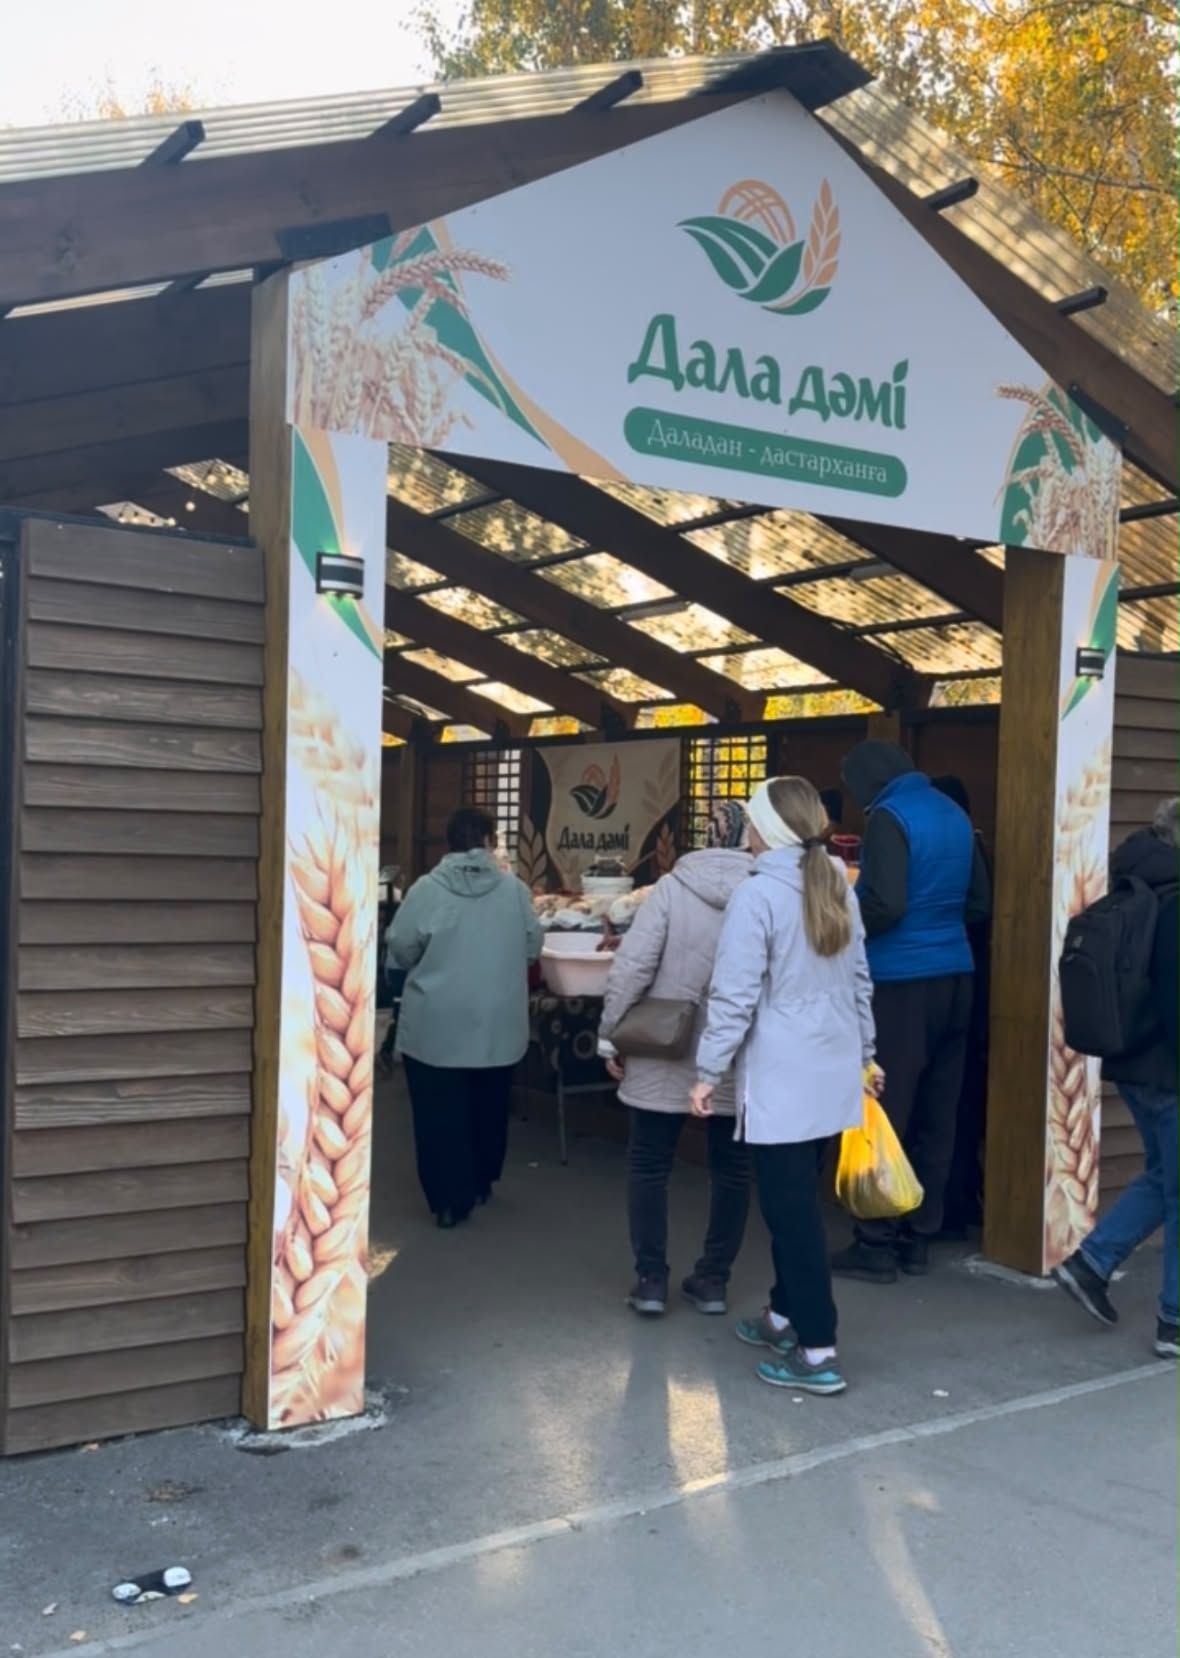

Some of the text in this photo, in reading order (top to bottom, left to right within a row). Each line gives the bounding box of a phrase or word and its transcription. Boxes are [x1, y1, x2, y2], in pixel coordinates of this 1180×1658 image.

[627, 313, 908, 429] Дала дәмі
[648, 419, 742, 457] Даладан
[760, 445, 888, 483] дастарханға
[558, 826, 595, 850] Дала
